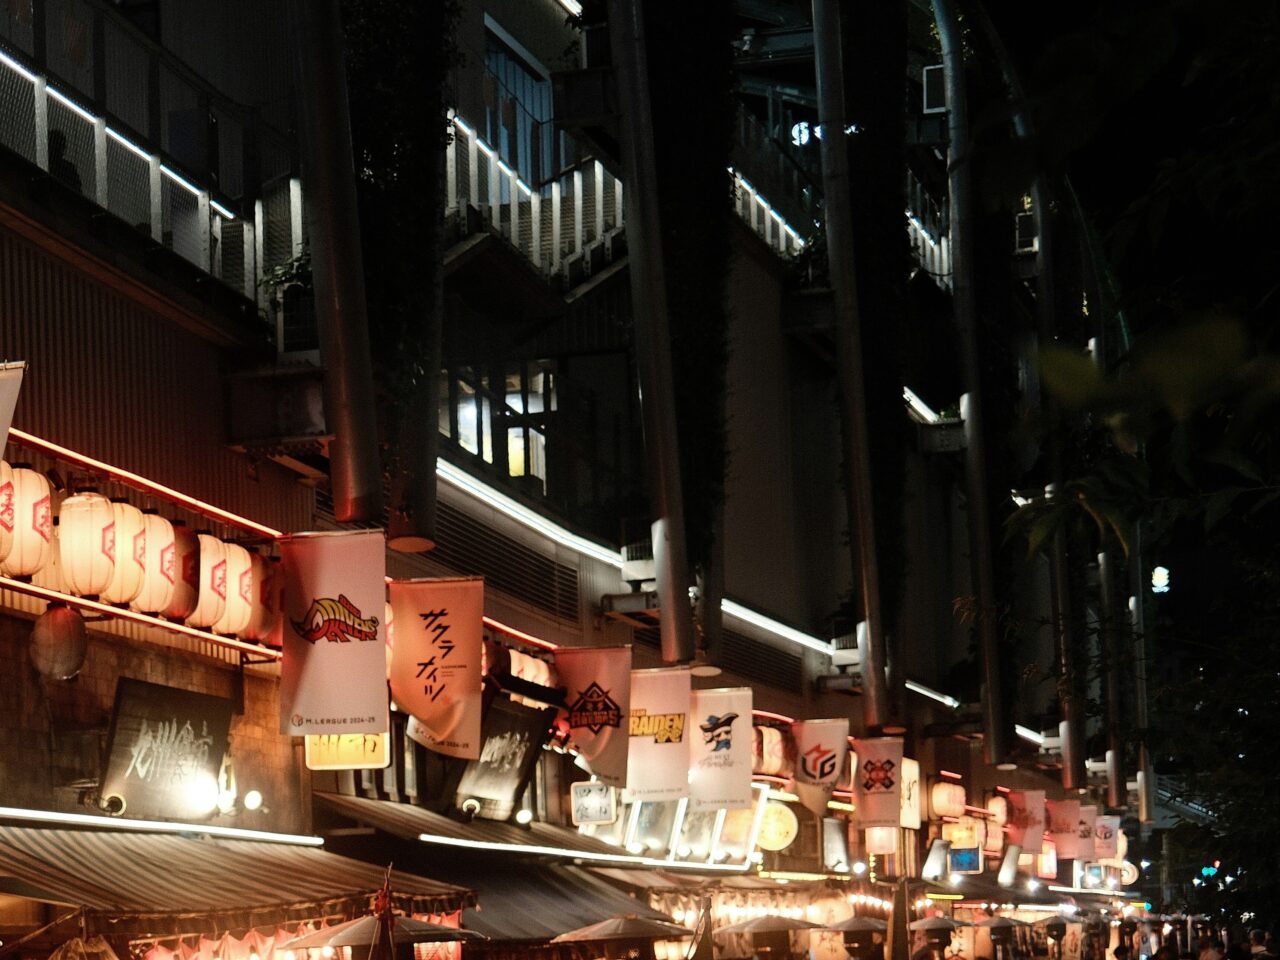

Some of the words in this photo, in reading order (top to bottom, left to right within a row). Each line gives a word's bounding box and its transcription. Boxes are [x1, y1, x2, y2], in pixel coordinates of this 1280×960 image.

[419, 608, 455, 660] サクラ
[415, 655, 446, 702] ナイツ
